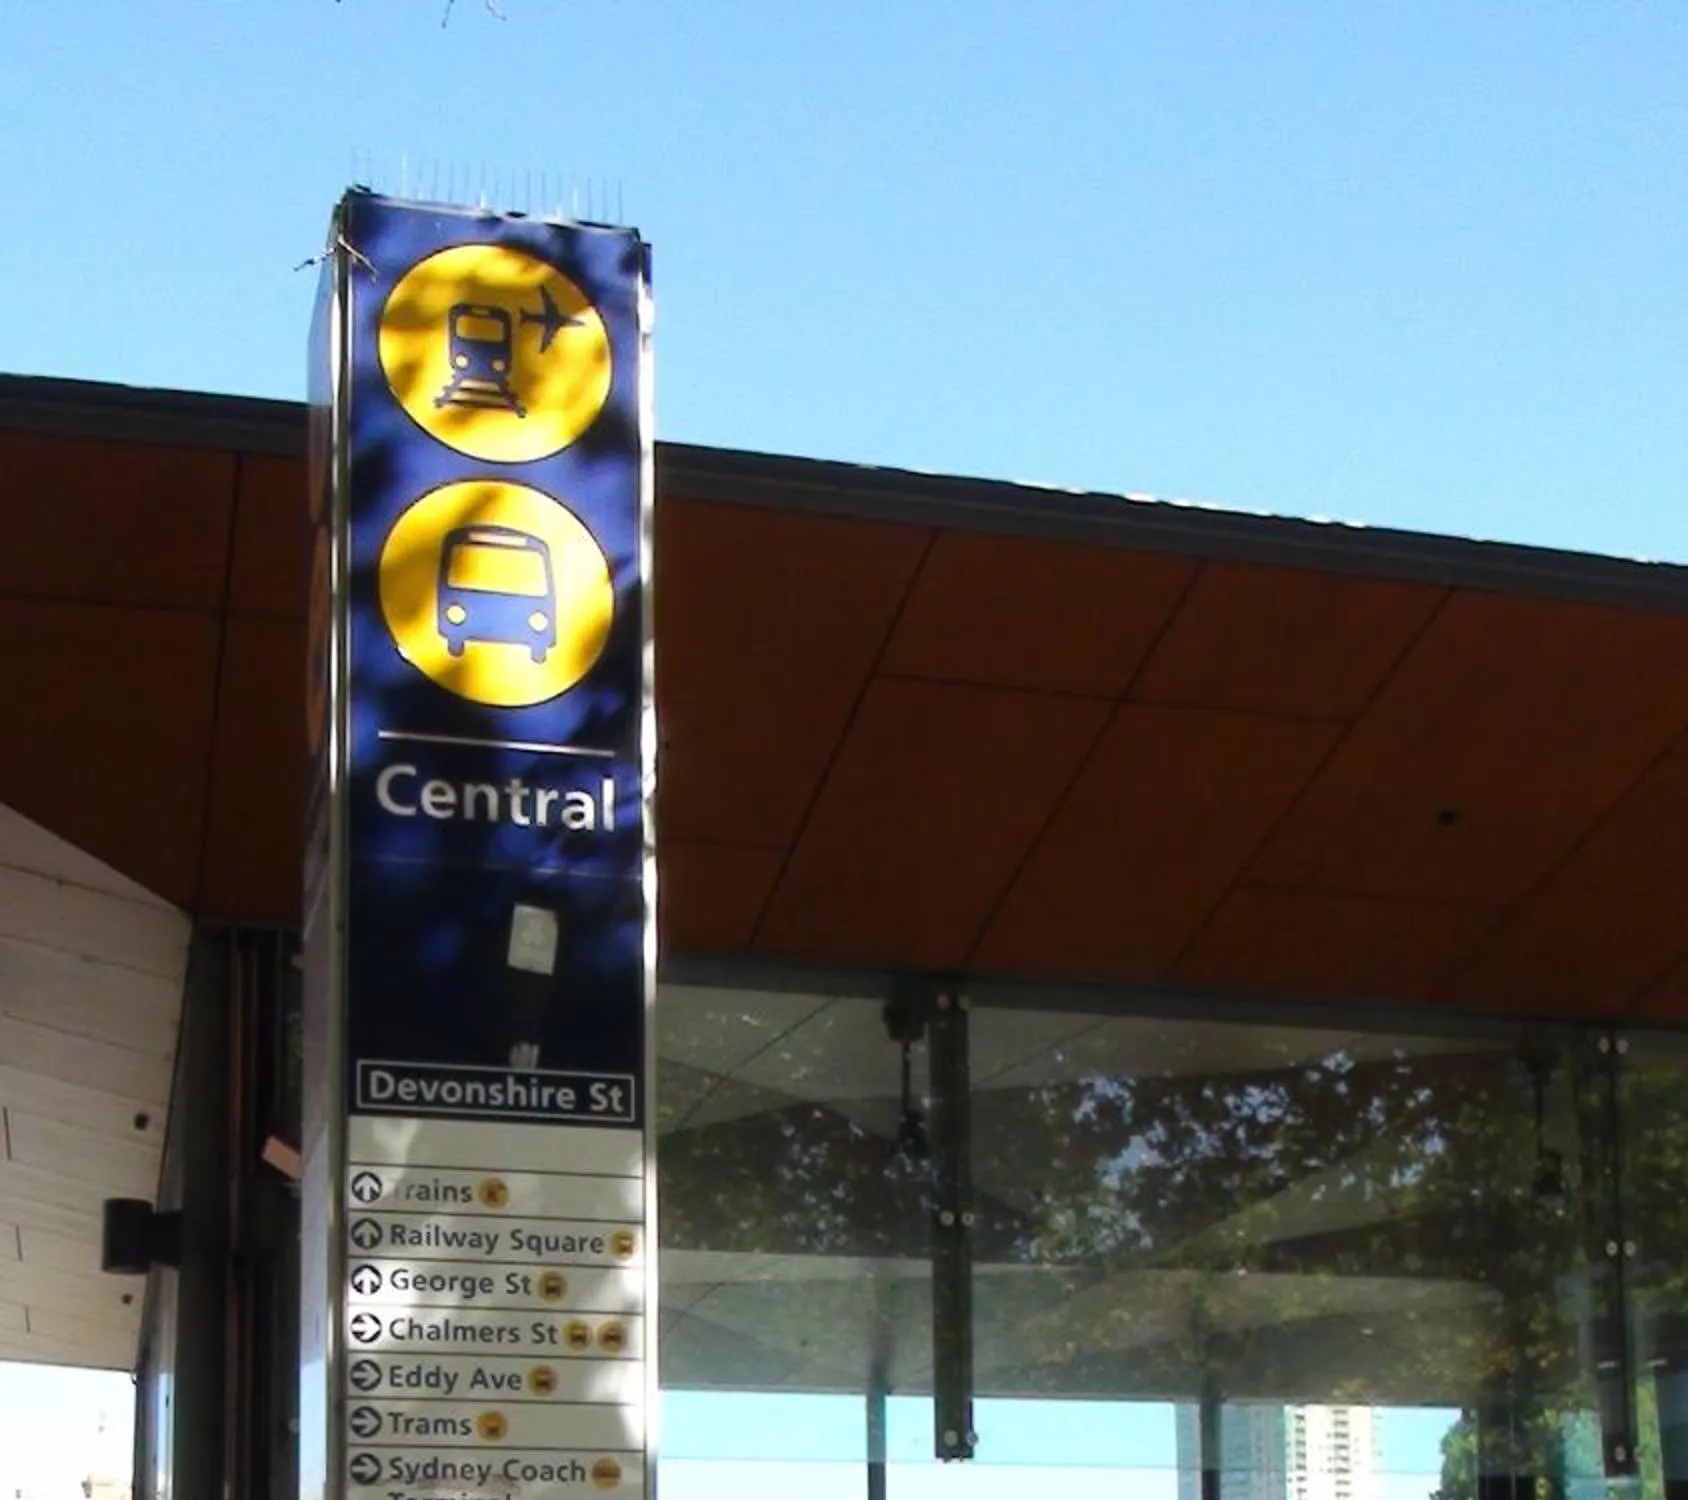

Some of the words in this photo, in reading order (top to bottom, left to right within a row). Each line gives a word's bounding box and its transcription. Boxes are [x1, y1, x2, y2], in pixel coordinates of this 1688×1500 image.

[375, 764, 615, 832] Central
[370, 1071, 575, 1110] Devonshire
[589, 1083, 623, 1112] St
[392, 1178, 473, 1203] rains
[389, 1224, 499, 1255] Railway
[510, 1228, 604, 1256] Square
[389, 1268, 494, 1298] George
[505, 1273, 531, 1295] St
[389, 1318, 521, 1344] Chalmers
[531, 1322, 558, 1345] St
[388, 1365, 458, 1394] Eddy
[470, 1367, 522, 1391] Ave
[388, 1411, 472, 1436] Trams
[388, 1456, 491, 1486] Sydney
[503, 1459, 586, 1483] Coach
